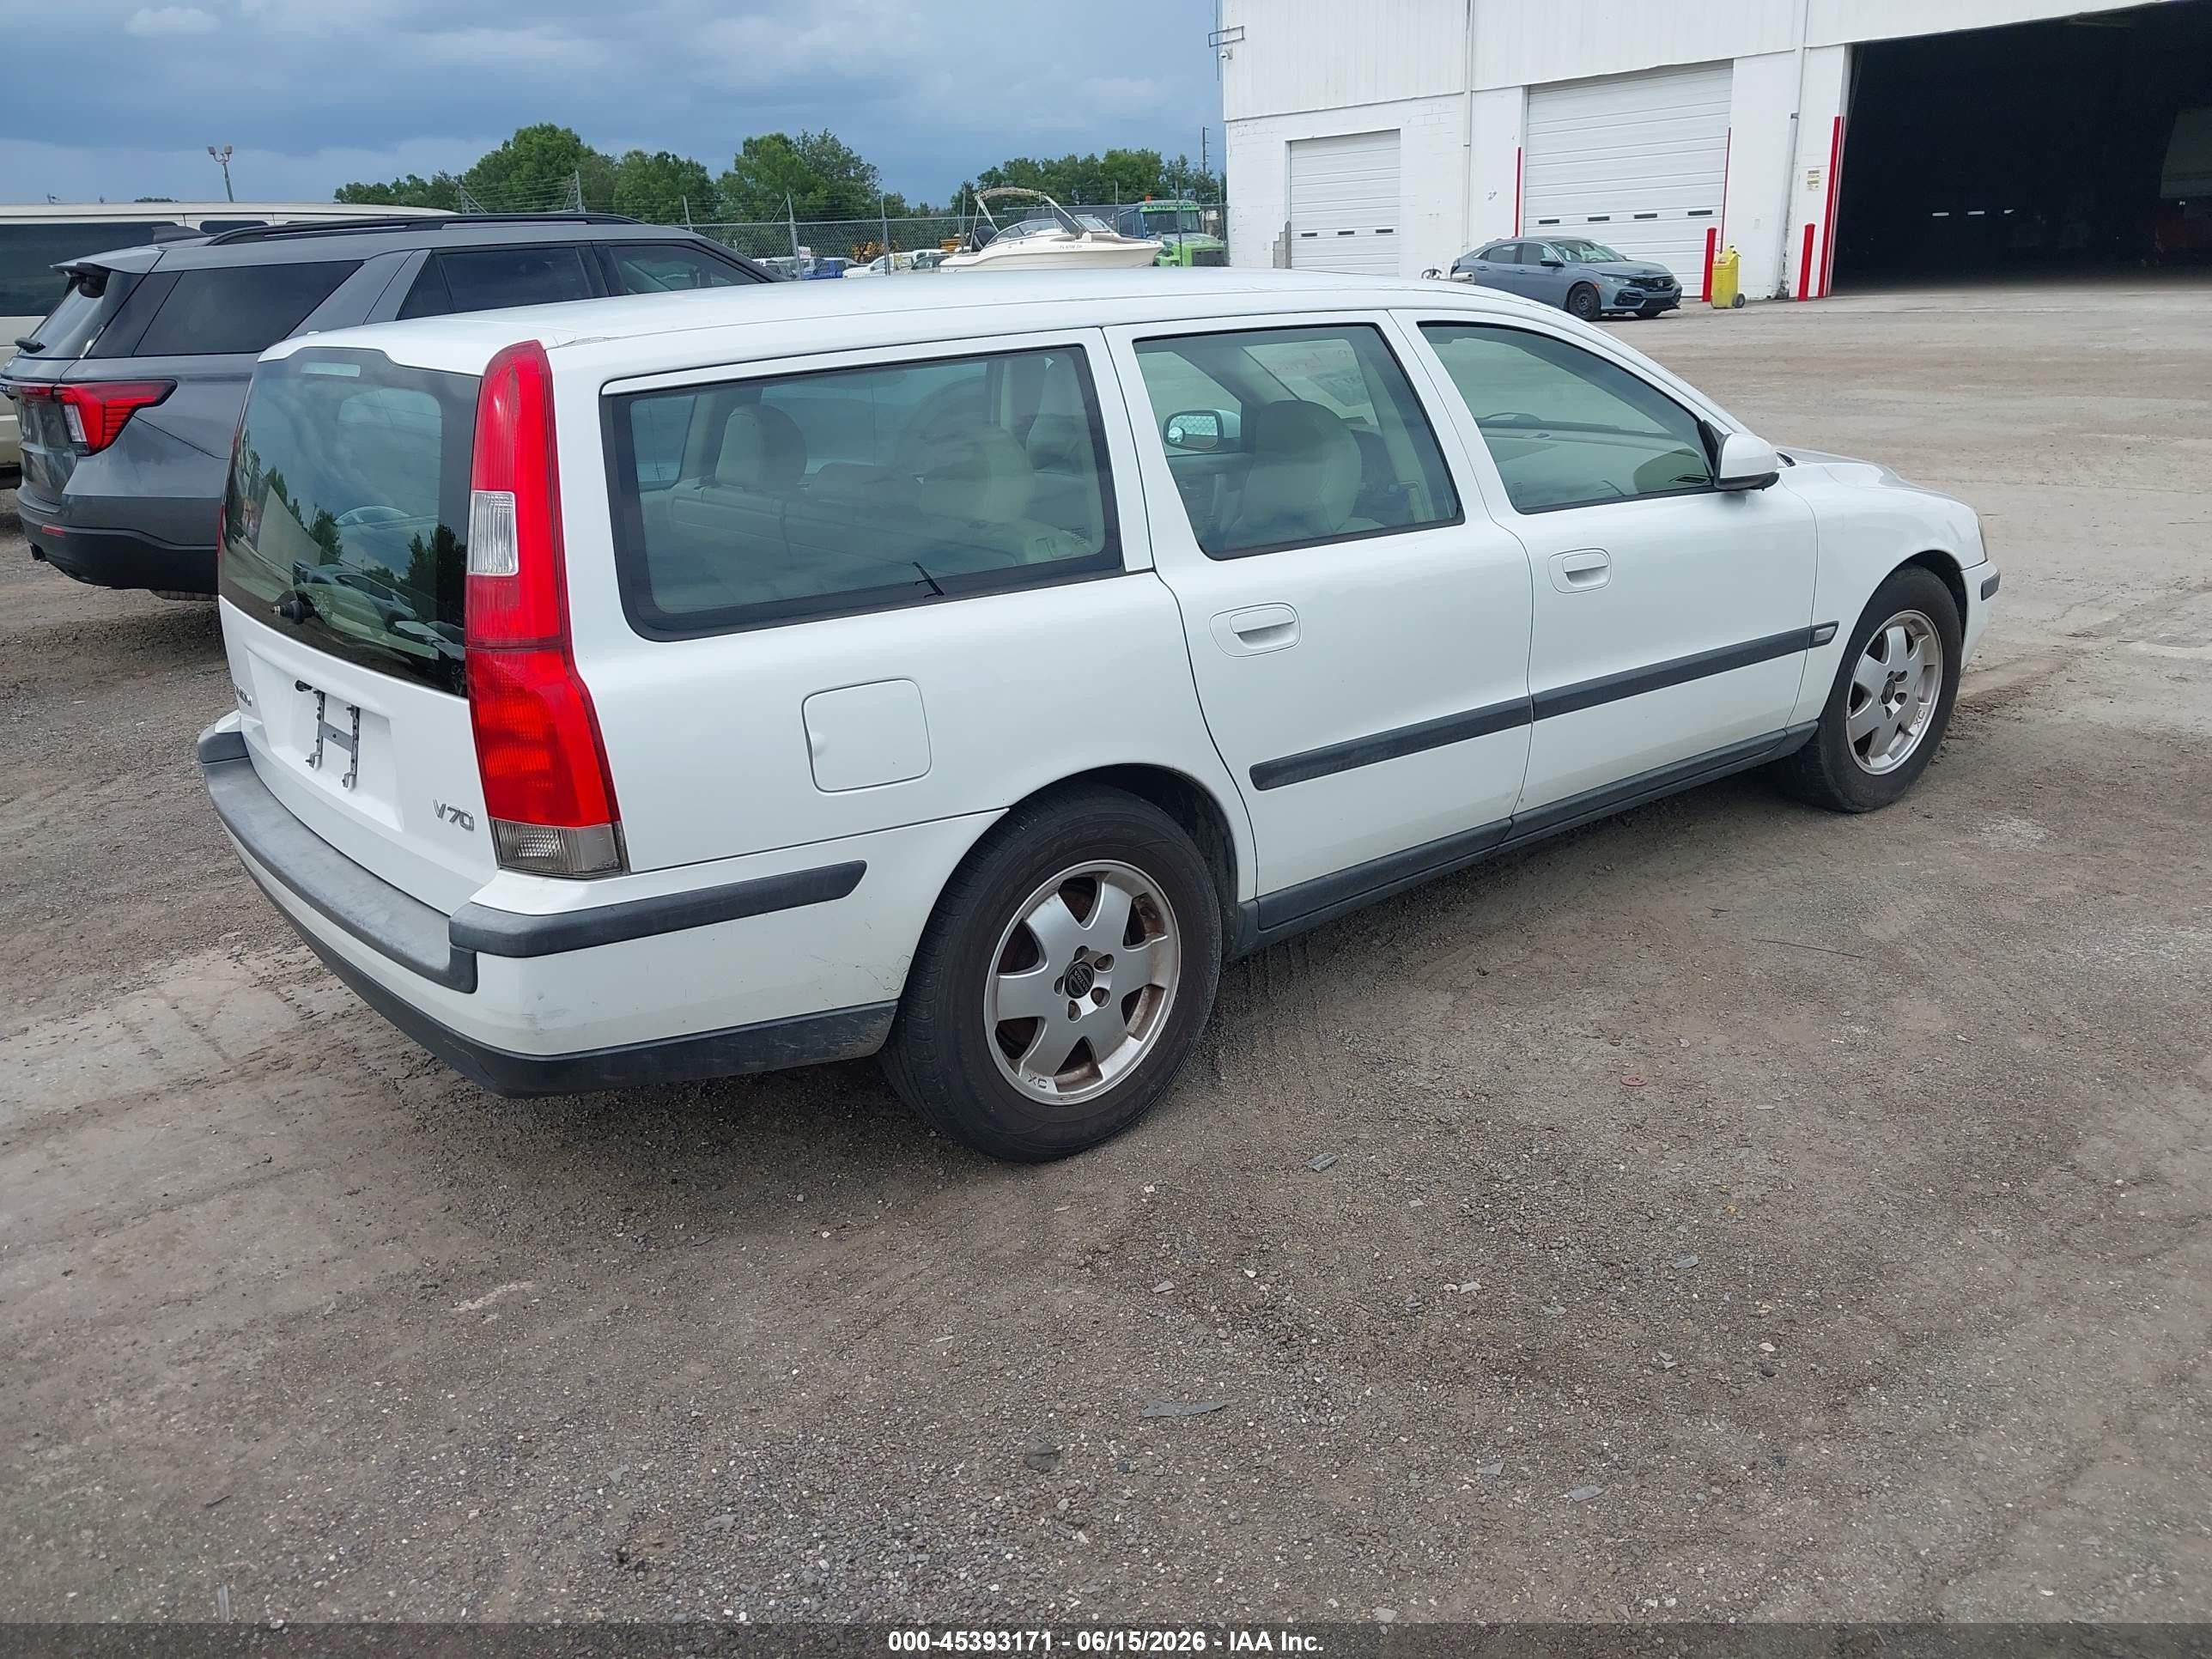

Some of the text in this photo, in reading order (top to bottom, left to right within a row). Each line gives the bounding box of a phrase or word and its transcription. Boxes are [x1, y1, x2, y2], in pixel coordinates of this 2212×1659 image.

[1913, 708, 1925, 728] XC
[432, 798, 475, 831] V70
[1073, 969, 1090, 992] VOLVO
[1027, 1073, 1048, 1090] XC
